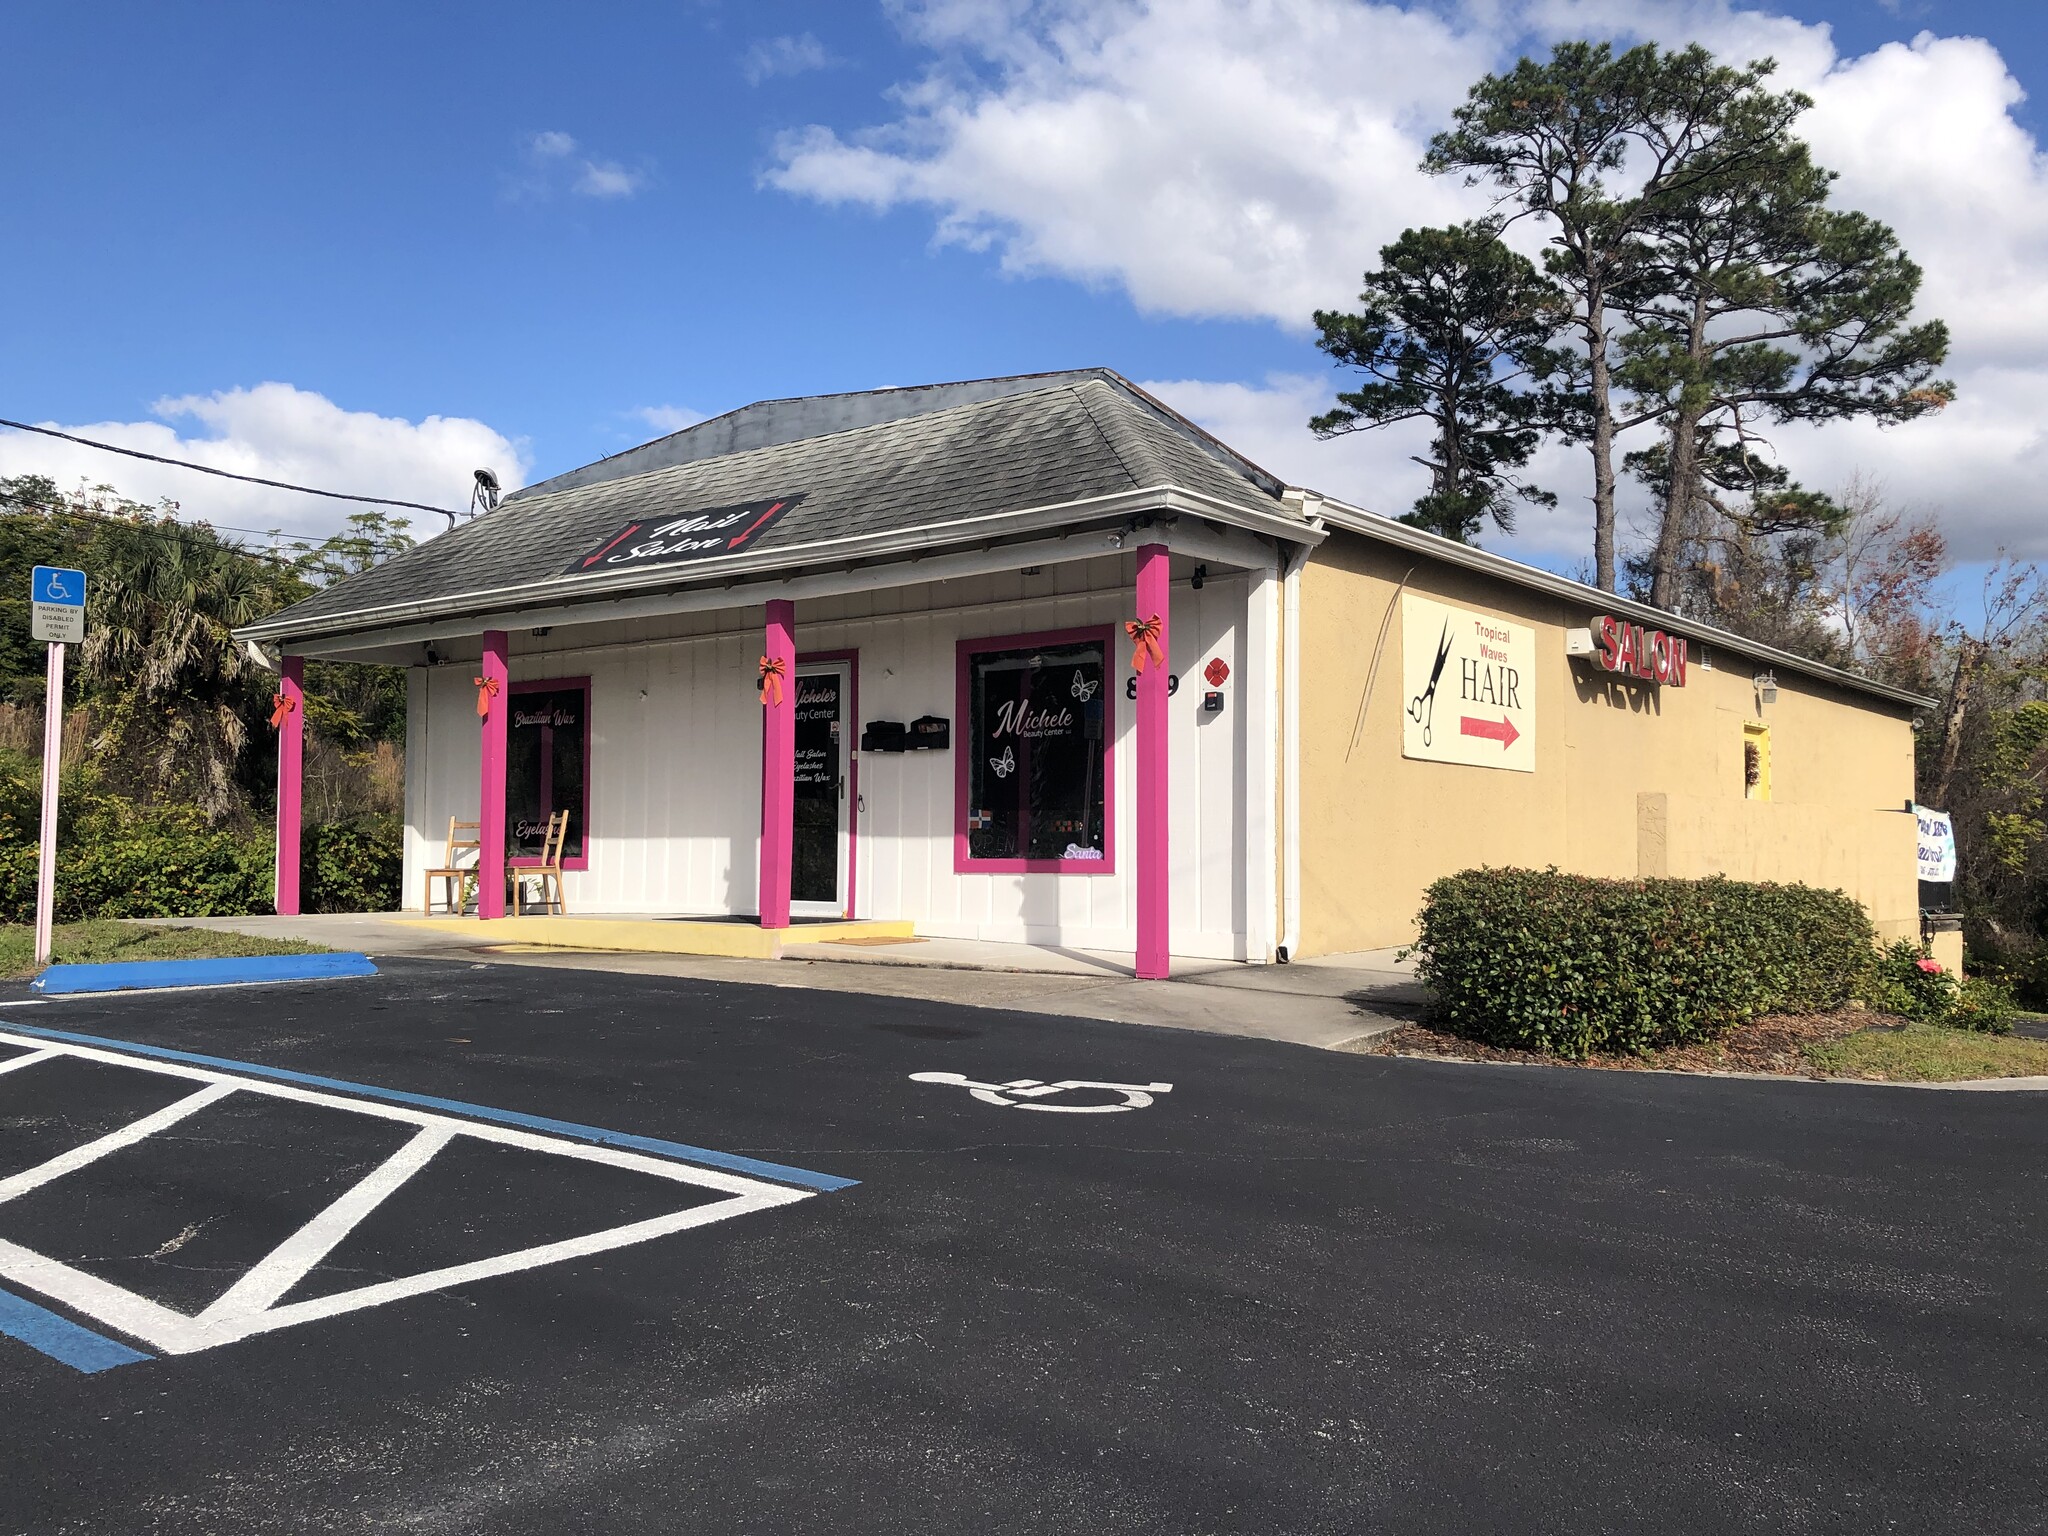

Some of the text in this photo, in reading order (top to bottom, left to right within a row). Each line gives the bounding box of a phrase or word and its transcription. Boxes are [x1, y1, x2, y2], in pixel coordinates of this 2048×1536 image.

[649, 511, 750, 538] Nail
[607, 537, 723, 563] Salon
[38, 605, 68, 614] PARKING
[42, 614, 75, 623] DISABLED
[45, 623, 70, 631] PERMIT
[48, 631, 67, 639] ONLY
[1474, 621, 1511, 644] Tropical
[1479, 643, 1508, 664] Waves
[1590, 614, 1687, 688] SALON
[1126, 674, 1180, 700] 89
[1460, 656, 1522, 710] HAIR
[514, 708, 576, 728] Brazilian Wax
[809, 708, 836, 720] Center
[992, 698, 1074, 739] Michele
[1023, 730, 1043, 738] Beauty
[1043, 728, 1064, 736] Center
[806, 748, 827, 760] Salon
[813, 772, 831, 783] Wax
[1064, 843, 1102, 860] Santa
